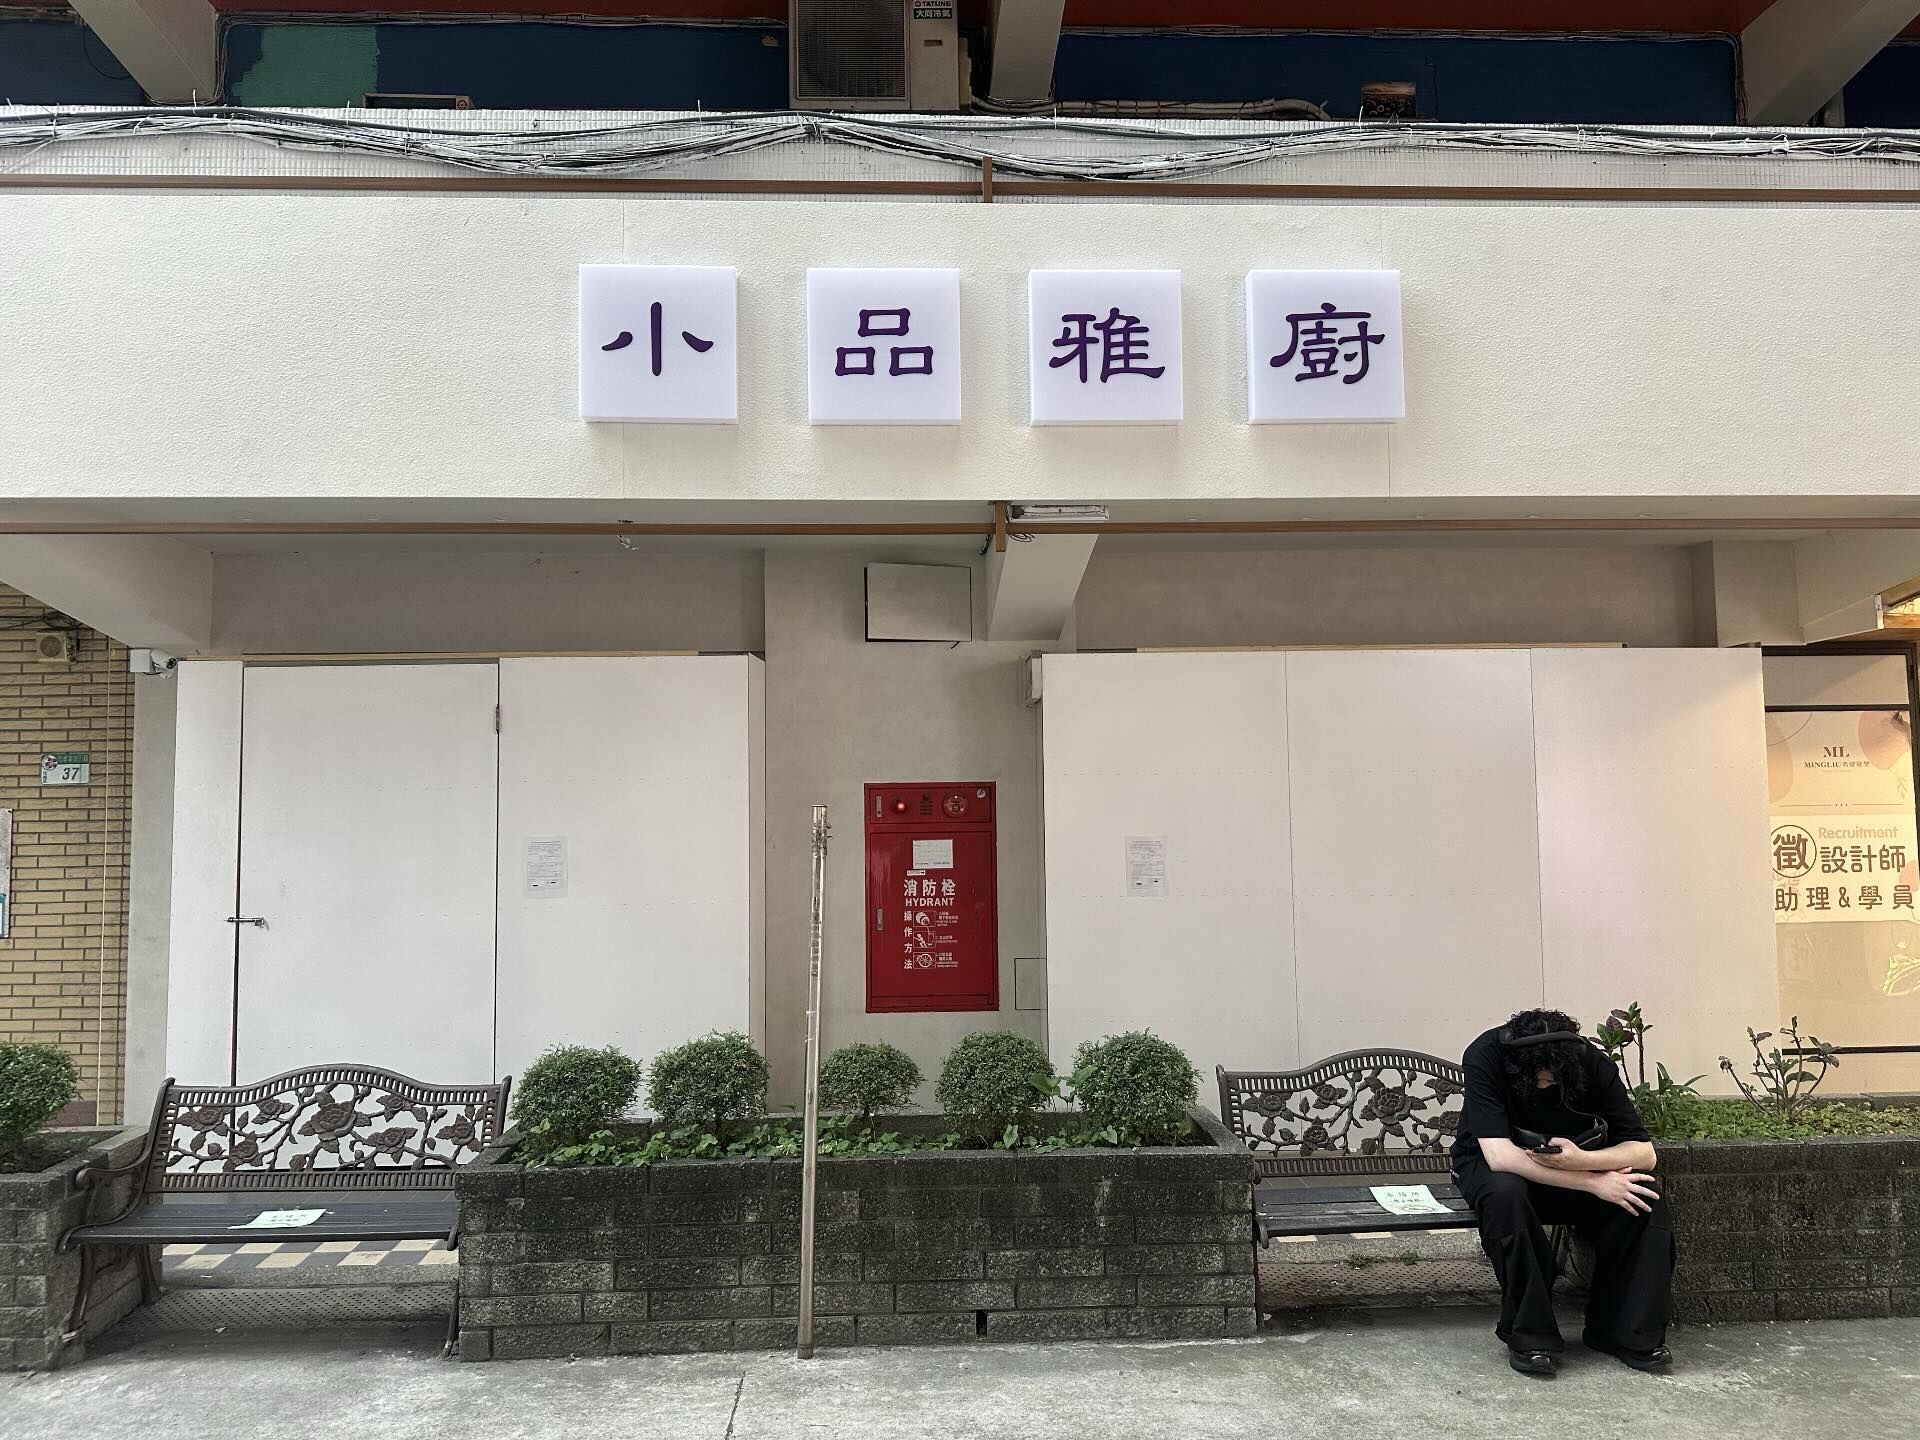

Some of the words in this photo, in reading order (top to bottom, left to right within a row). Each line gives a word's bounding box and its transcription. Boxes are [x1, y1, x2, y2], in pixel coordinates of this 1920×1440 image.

[602, 302, 1386, 384] 小品雅廚
[1823, 746, 1850, 758] ML
[1804, 761, 1840, 769] MINGLIU
[62, 767, 80, 781] 37
[1818, 826, 1899, 840] Recruitment
[1772, 833, 1810, 871] 徵
[1819, 844, 1906, 874] 設計師
[903, 878, 956, 897] 消防栓
[905, 897, 955, 907] HYDRANT
[1774, 884, 1915, 912] 助理&學員
[903, 910, 913, 970] 操作方法
